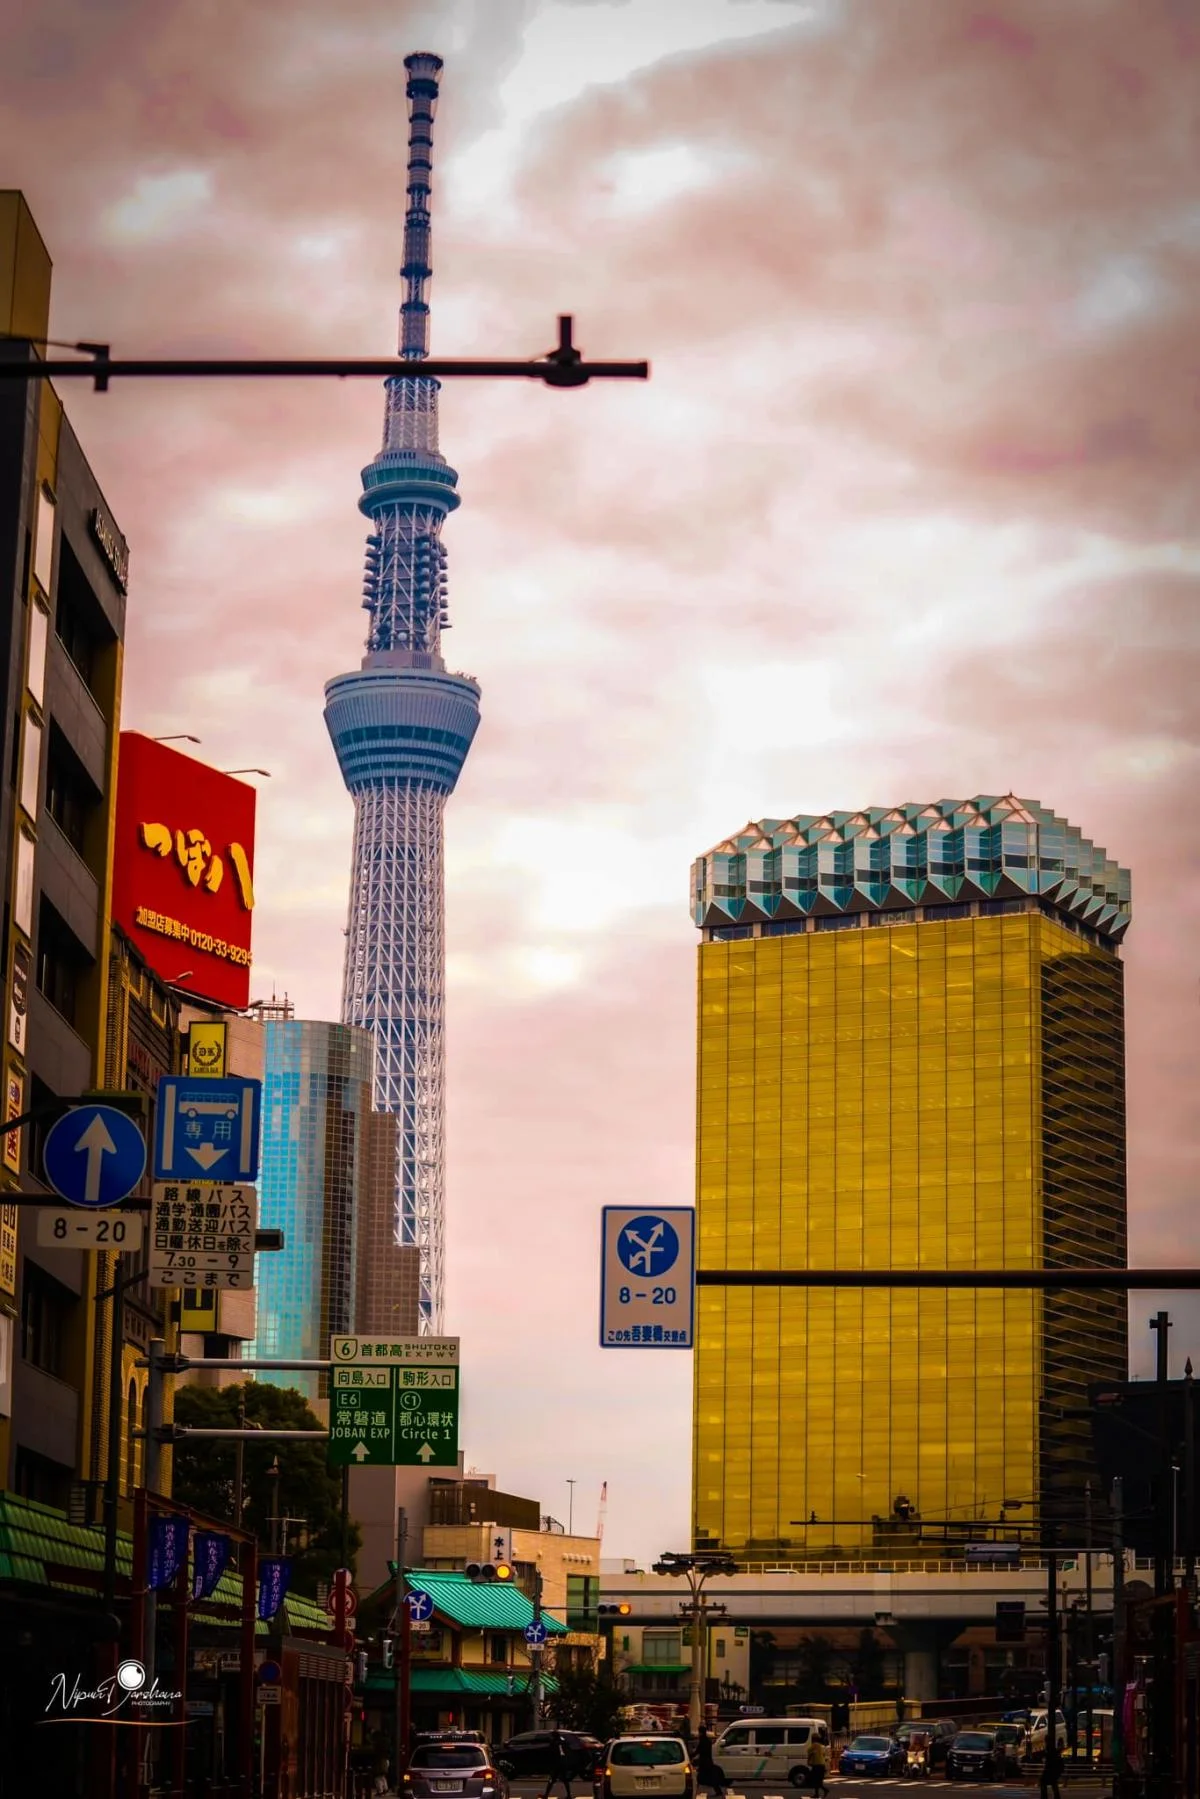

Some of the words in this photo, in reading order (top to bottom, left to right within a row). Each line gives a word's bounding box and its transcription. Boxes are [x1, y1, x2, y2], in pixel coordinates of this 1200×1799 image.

[140, 822, 255, 910] つぼ八
[136, 905, 190, 942] 加盟店募集中
[184, 1119, 232, 1140] 専用
[164, 1187, 244, 1203] 路線バス
[155, 1217, 250, 1233] 通勤送迎バス
[161, 1271, 240, 1287] ここまで
[341, 1342, 350, 1356] 6
[360, 1344, 402, 1357] 首都高
[338, 1370, 386, 1385] 向島入口
[403, 1371, 451, 1386] 駒形入口
[340, 1394, 357, 1405] E6
[404, 1395, 417, 1406] C1
[337, 1410, 387, 1426] 常磐道
[400, 1411, 454, 1427] 都心環状
[331, 1427, 366, 1440] JOBAN
[370, 1428, 391, 1439] EXP
[401, 1428, 439, 1440] Circle
[444, 1429, 452, 1440] 1
[494, 1536, 505, 1561] 水上
